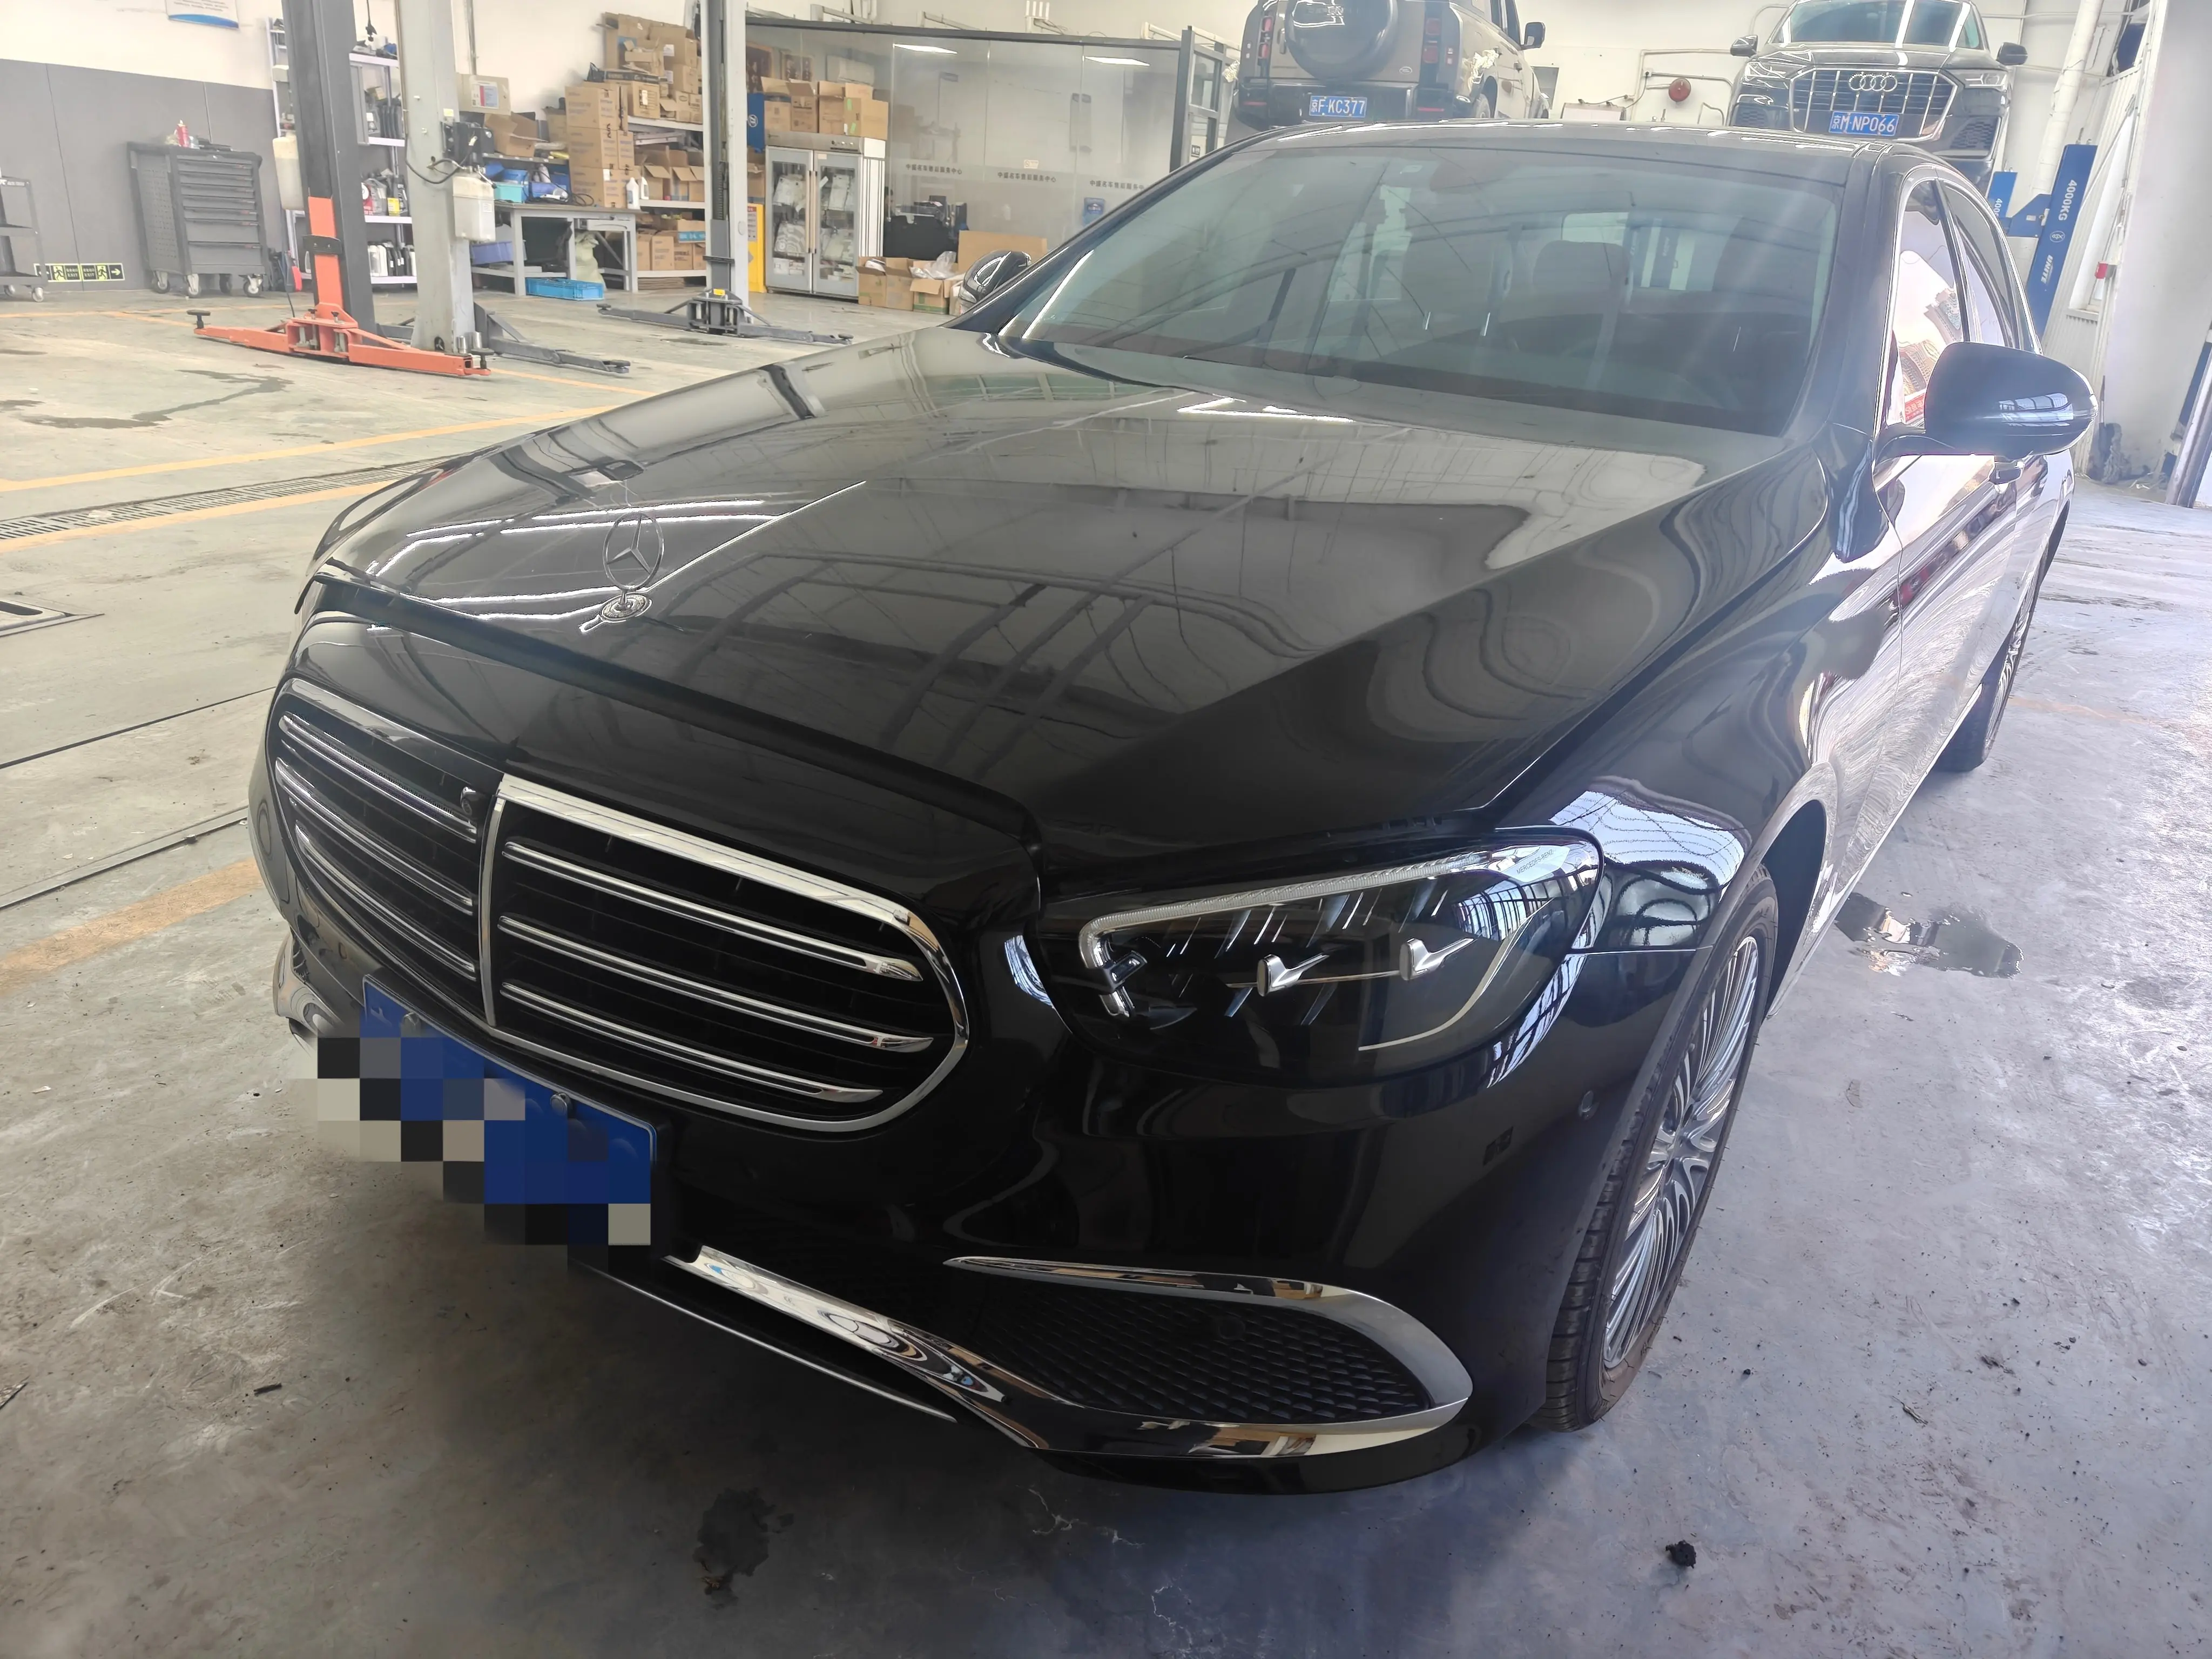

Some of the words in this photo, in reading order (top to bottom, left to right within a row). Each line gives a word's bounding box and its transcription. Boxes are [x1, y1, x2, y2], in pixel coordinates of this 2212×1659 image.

[2058, 179, 2078, 220] 4000KG
[2041, 254, 2053, 284] UNITE
[1516, 849, 1554, 874] MERCEDES-BENZ
